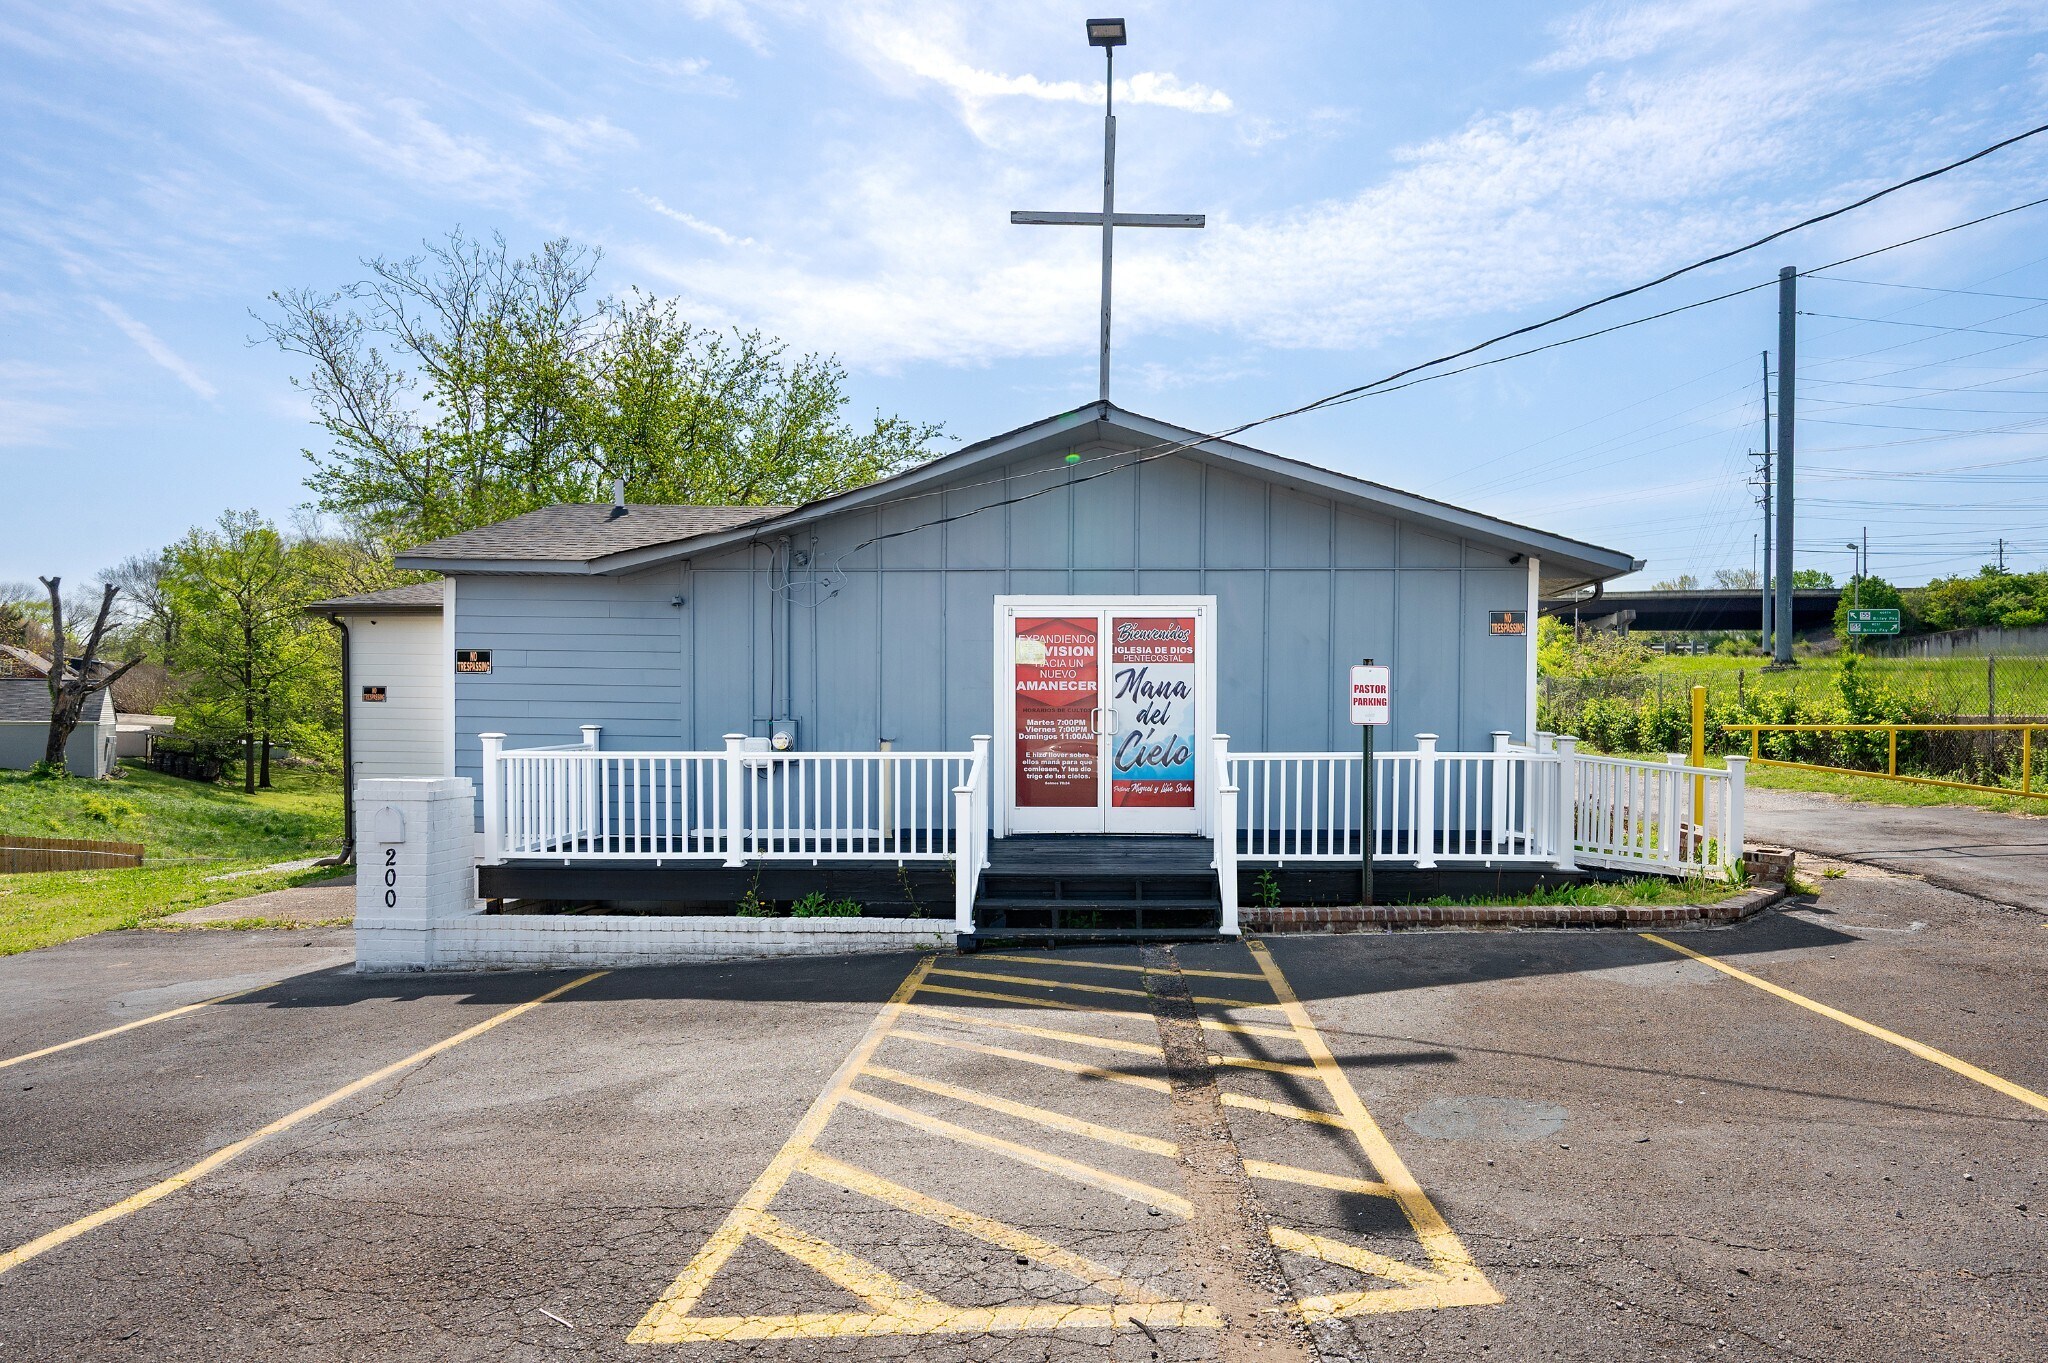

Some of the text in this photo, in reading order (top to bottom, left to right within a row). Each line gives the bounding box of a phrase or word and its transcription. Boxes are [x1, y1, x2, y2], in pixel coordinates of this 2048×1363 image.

[1504, 612, 1512, 623] NO
[1117, 622, 1190, 643] Bienvenidos
[1491, 623, 1525, 634] TRESPASSING
[1018, 634, 1096, 644] EXPANDIENDO
[1045, 646, 1094, 657] VISION
[1114, 646, 1193, 654] IGLESIA DE DIOS
[470, 651, 478, 662] NO
[1123, 654, 1183, 662] PENTECOSTAL
[457, 661, 490, 672] TRESPASSING
[1068, 659, 1084, 668] UN
[1040, 669, 1077, 678] NUEVO
[1016, 680, 1097, 691] AMANECER
[1114, 666, 1192, 704] Mana
[1353, 684, 1387, 694] PASTOR
[1353, 697, 1387, 707] PARKING
[1135, 700, 1171, 726] del
[1018, 733, 1058, 741] Domingos
[1114, 727, 1193, 773] Cielo
[385, 848, 396, 908] 200
